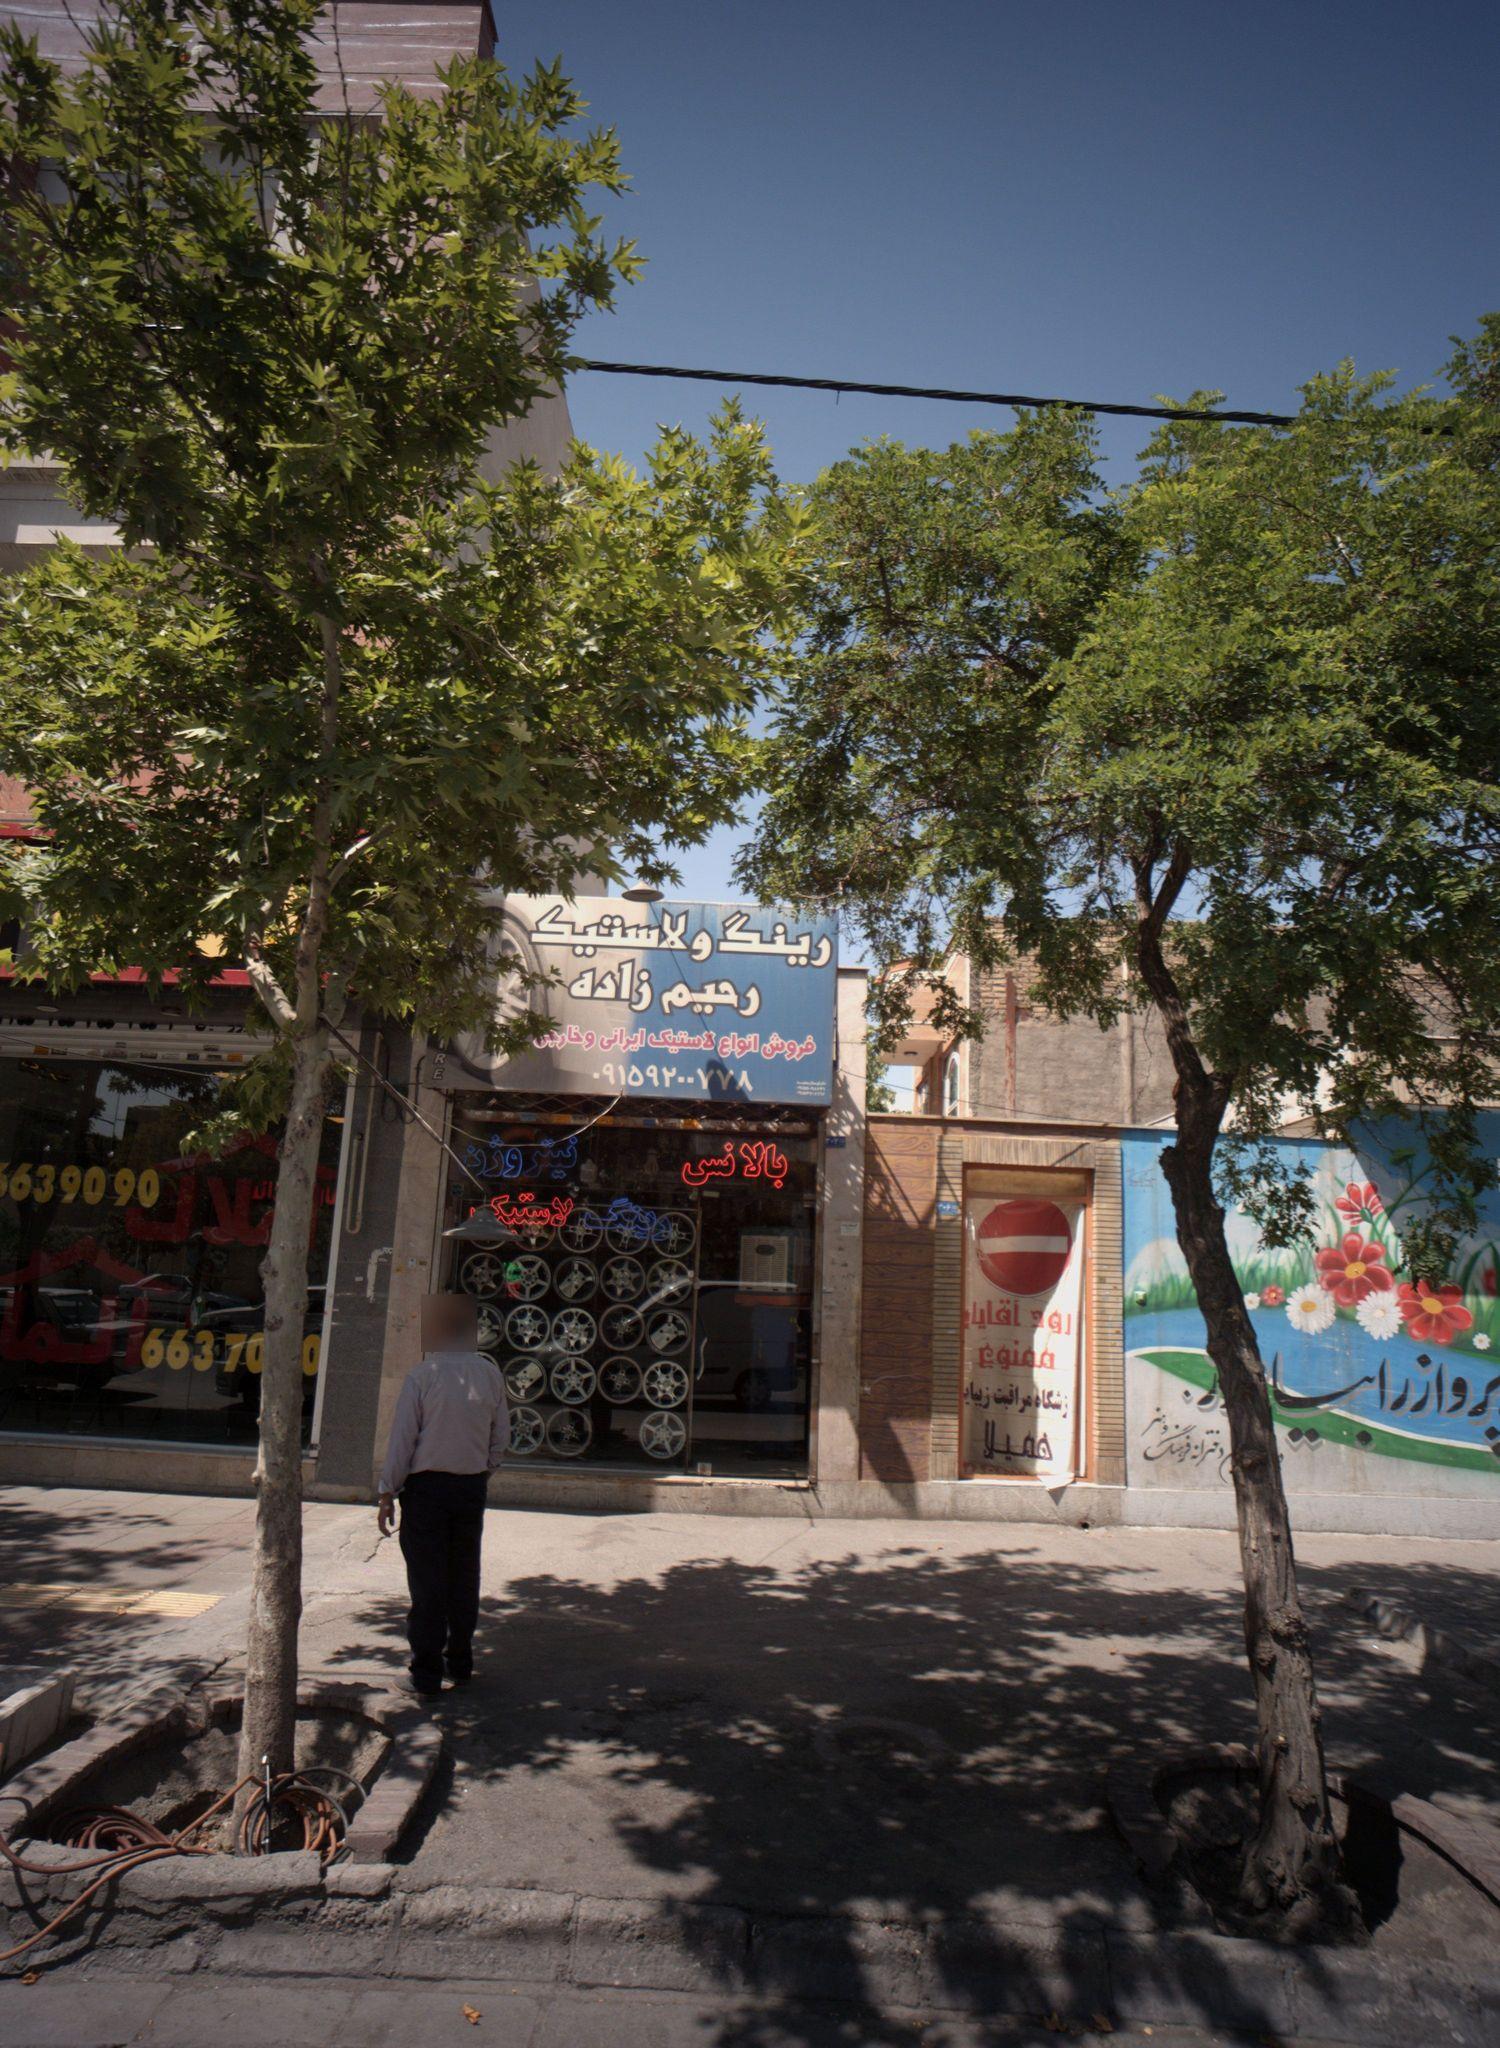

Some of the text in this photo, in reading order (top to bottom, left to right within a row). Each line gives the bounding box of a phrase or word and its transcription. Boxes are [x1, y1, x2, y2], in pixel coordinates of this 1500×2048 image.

[717, 910, 833, 969] رینگ
[567, 958, 762, 1018] رحیم زاده
[598, 1026, 647, 1051] ایرانی
[648, 1028, 717, 1052] لاستیک
[718, 1031, 760, 1059] انواع
[760, 1033, 818, 1061] فروش
[140, 1327, 321, 1377] 663700
